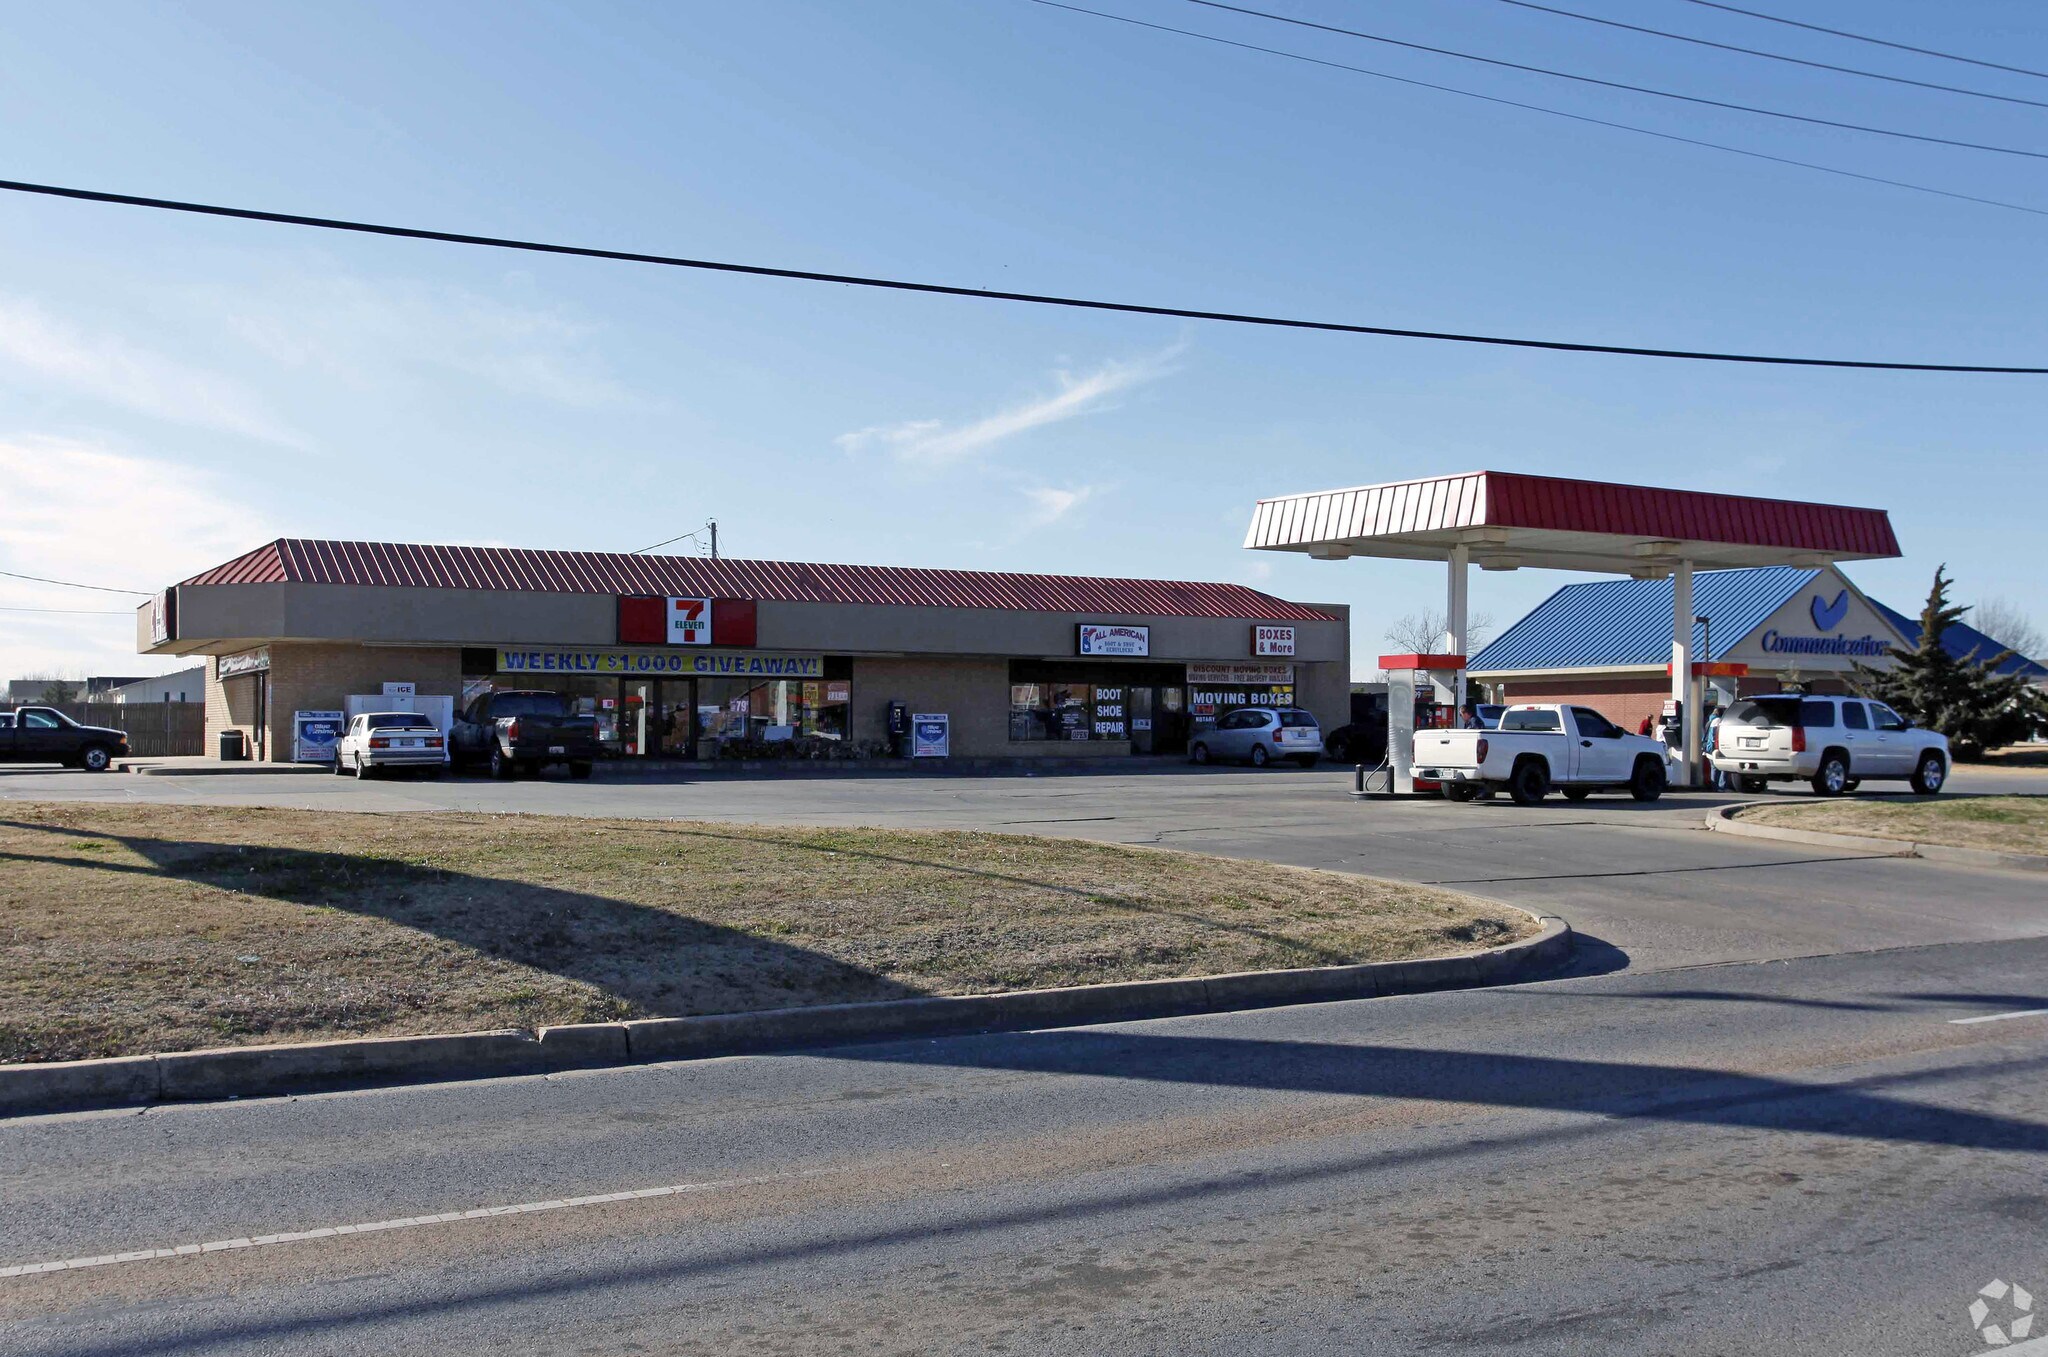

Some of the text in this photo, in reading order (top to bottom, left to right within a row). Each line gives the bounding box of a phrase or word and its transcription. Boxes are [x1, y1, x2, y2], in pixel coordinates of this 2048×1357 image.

[676, 600, 704, 642] 7
[1094, 628, 1145, 642] ALL AMERICAN
[1259, 629, 1292, 640] BOXES
[1260, 642, 1293, 653] & More
[504, 652, 817, 674] WEEKLY $1,000 GIVEAWAY!
[1193, 664, 1287, 674] DISCOUNT MOVING BOXES
[1096, 688, 1122, 700] BOOT
[1193, 692, 1293, 705] MOVING BOXES
[1096, 705, 1122, 717] SHOE
[1095, 721, 1124, 733] REPAIR
[1071, 731, 1088, 739] OPEN
